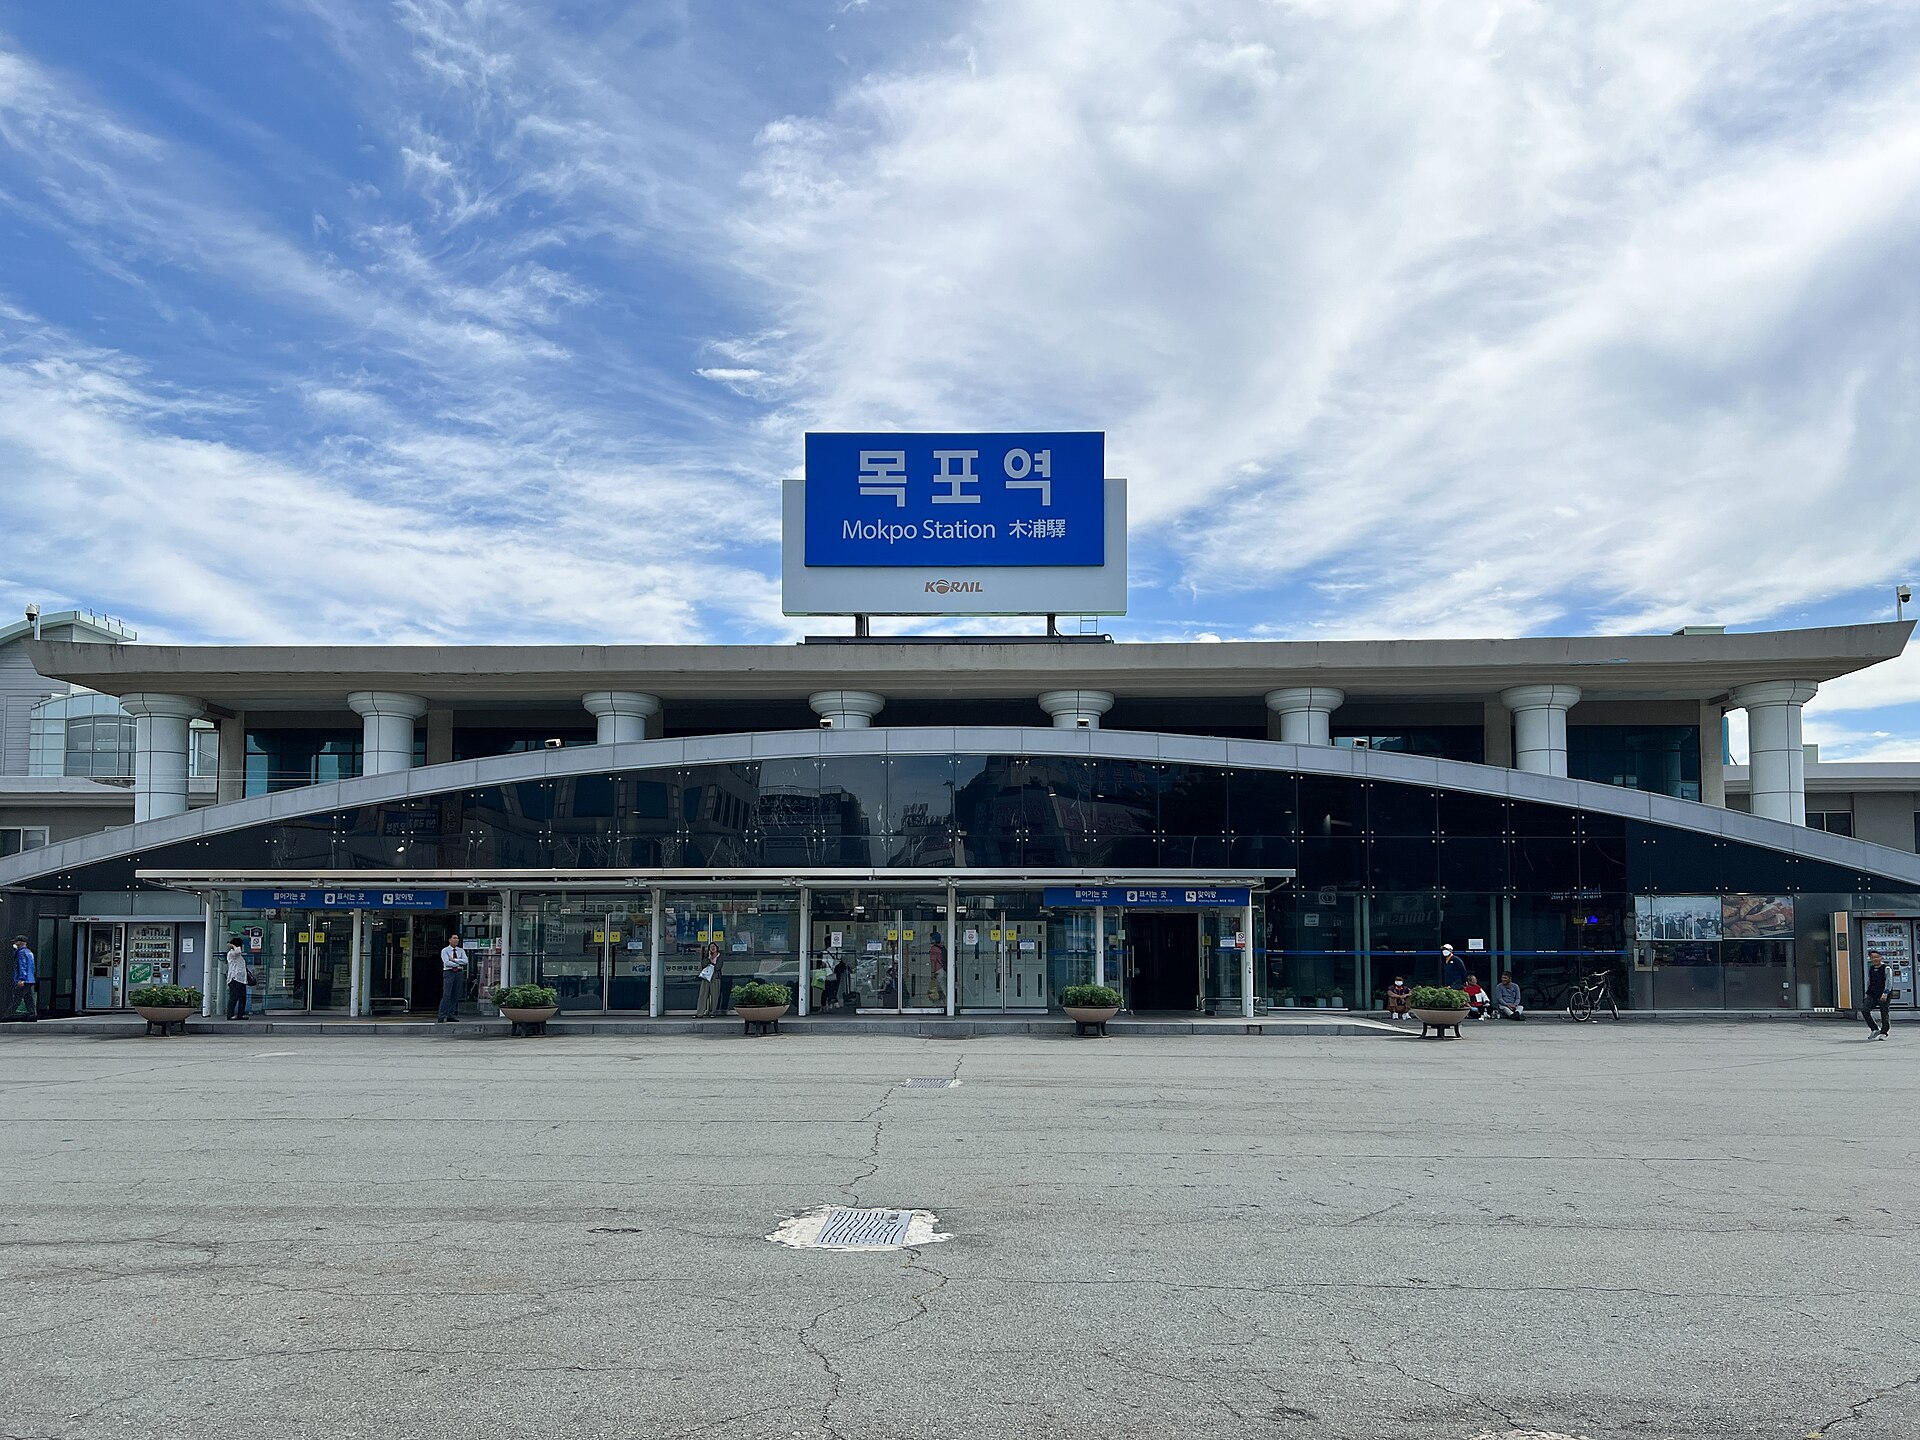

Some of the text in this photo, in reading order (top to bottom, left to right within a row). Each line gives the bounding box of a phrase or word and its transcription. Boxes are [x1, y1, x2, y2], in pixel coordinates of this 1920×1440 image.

[842, 519, 996, 544] Mokpo Station
[1008, 519, 1066, 539] 木浦驛
[924, 578, 984, 594] KORAIL
